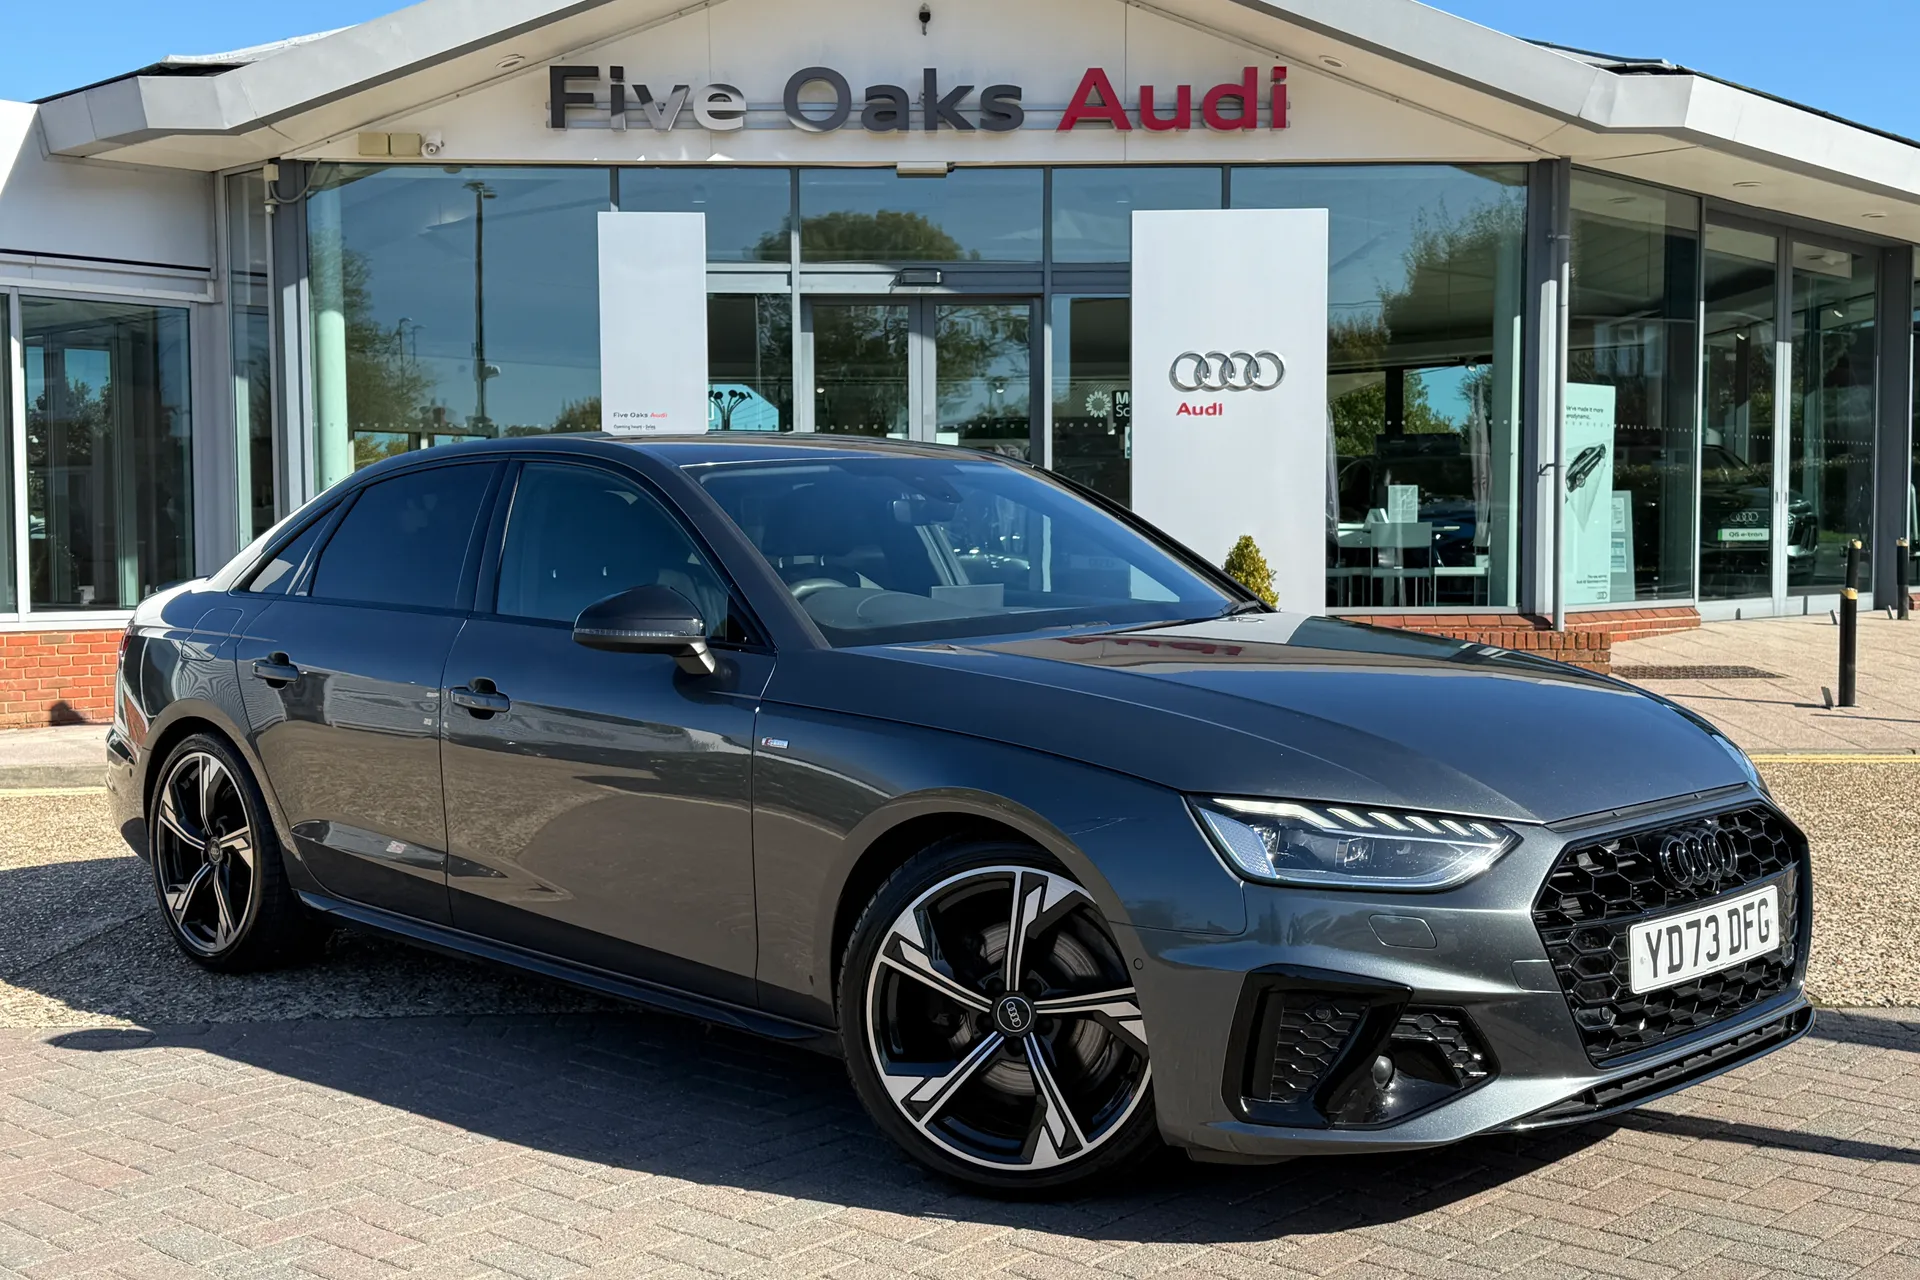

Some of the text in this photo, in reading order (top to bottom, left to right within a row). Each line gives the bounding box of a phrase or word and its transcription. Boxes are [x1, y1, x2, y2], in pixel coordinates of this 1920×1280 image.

[549, 65, 1288, 133] Five Oaks Audi
[1115, 391, 1130, 404] M
[1176, 402, 1223, 416] Audi
[1645, 897, 1770, 979] YD73 DFG
